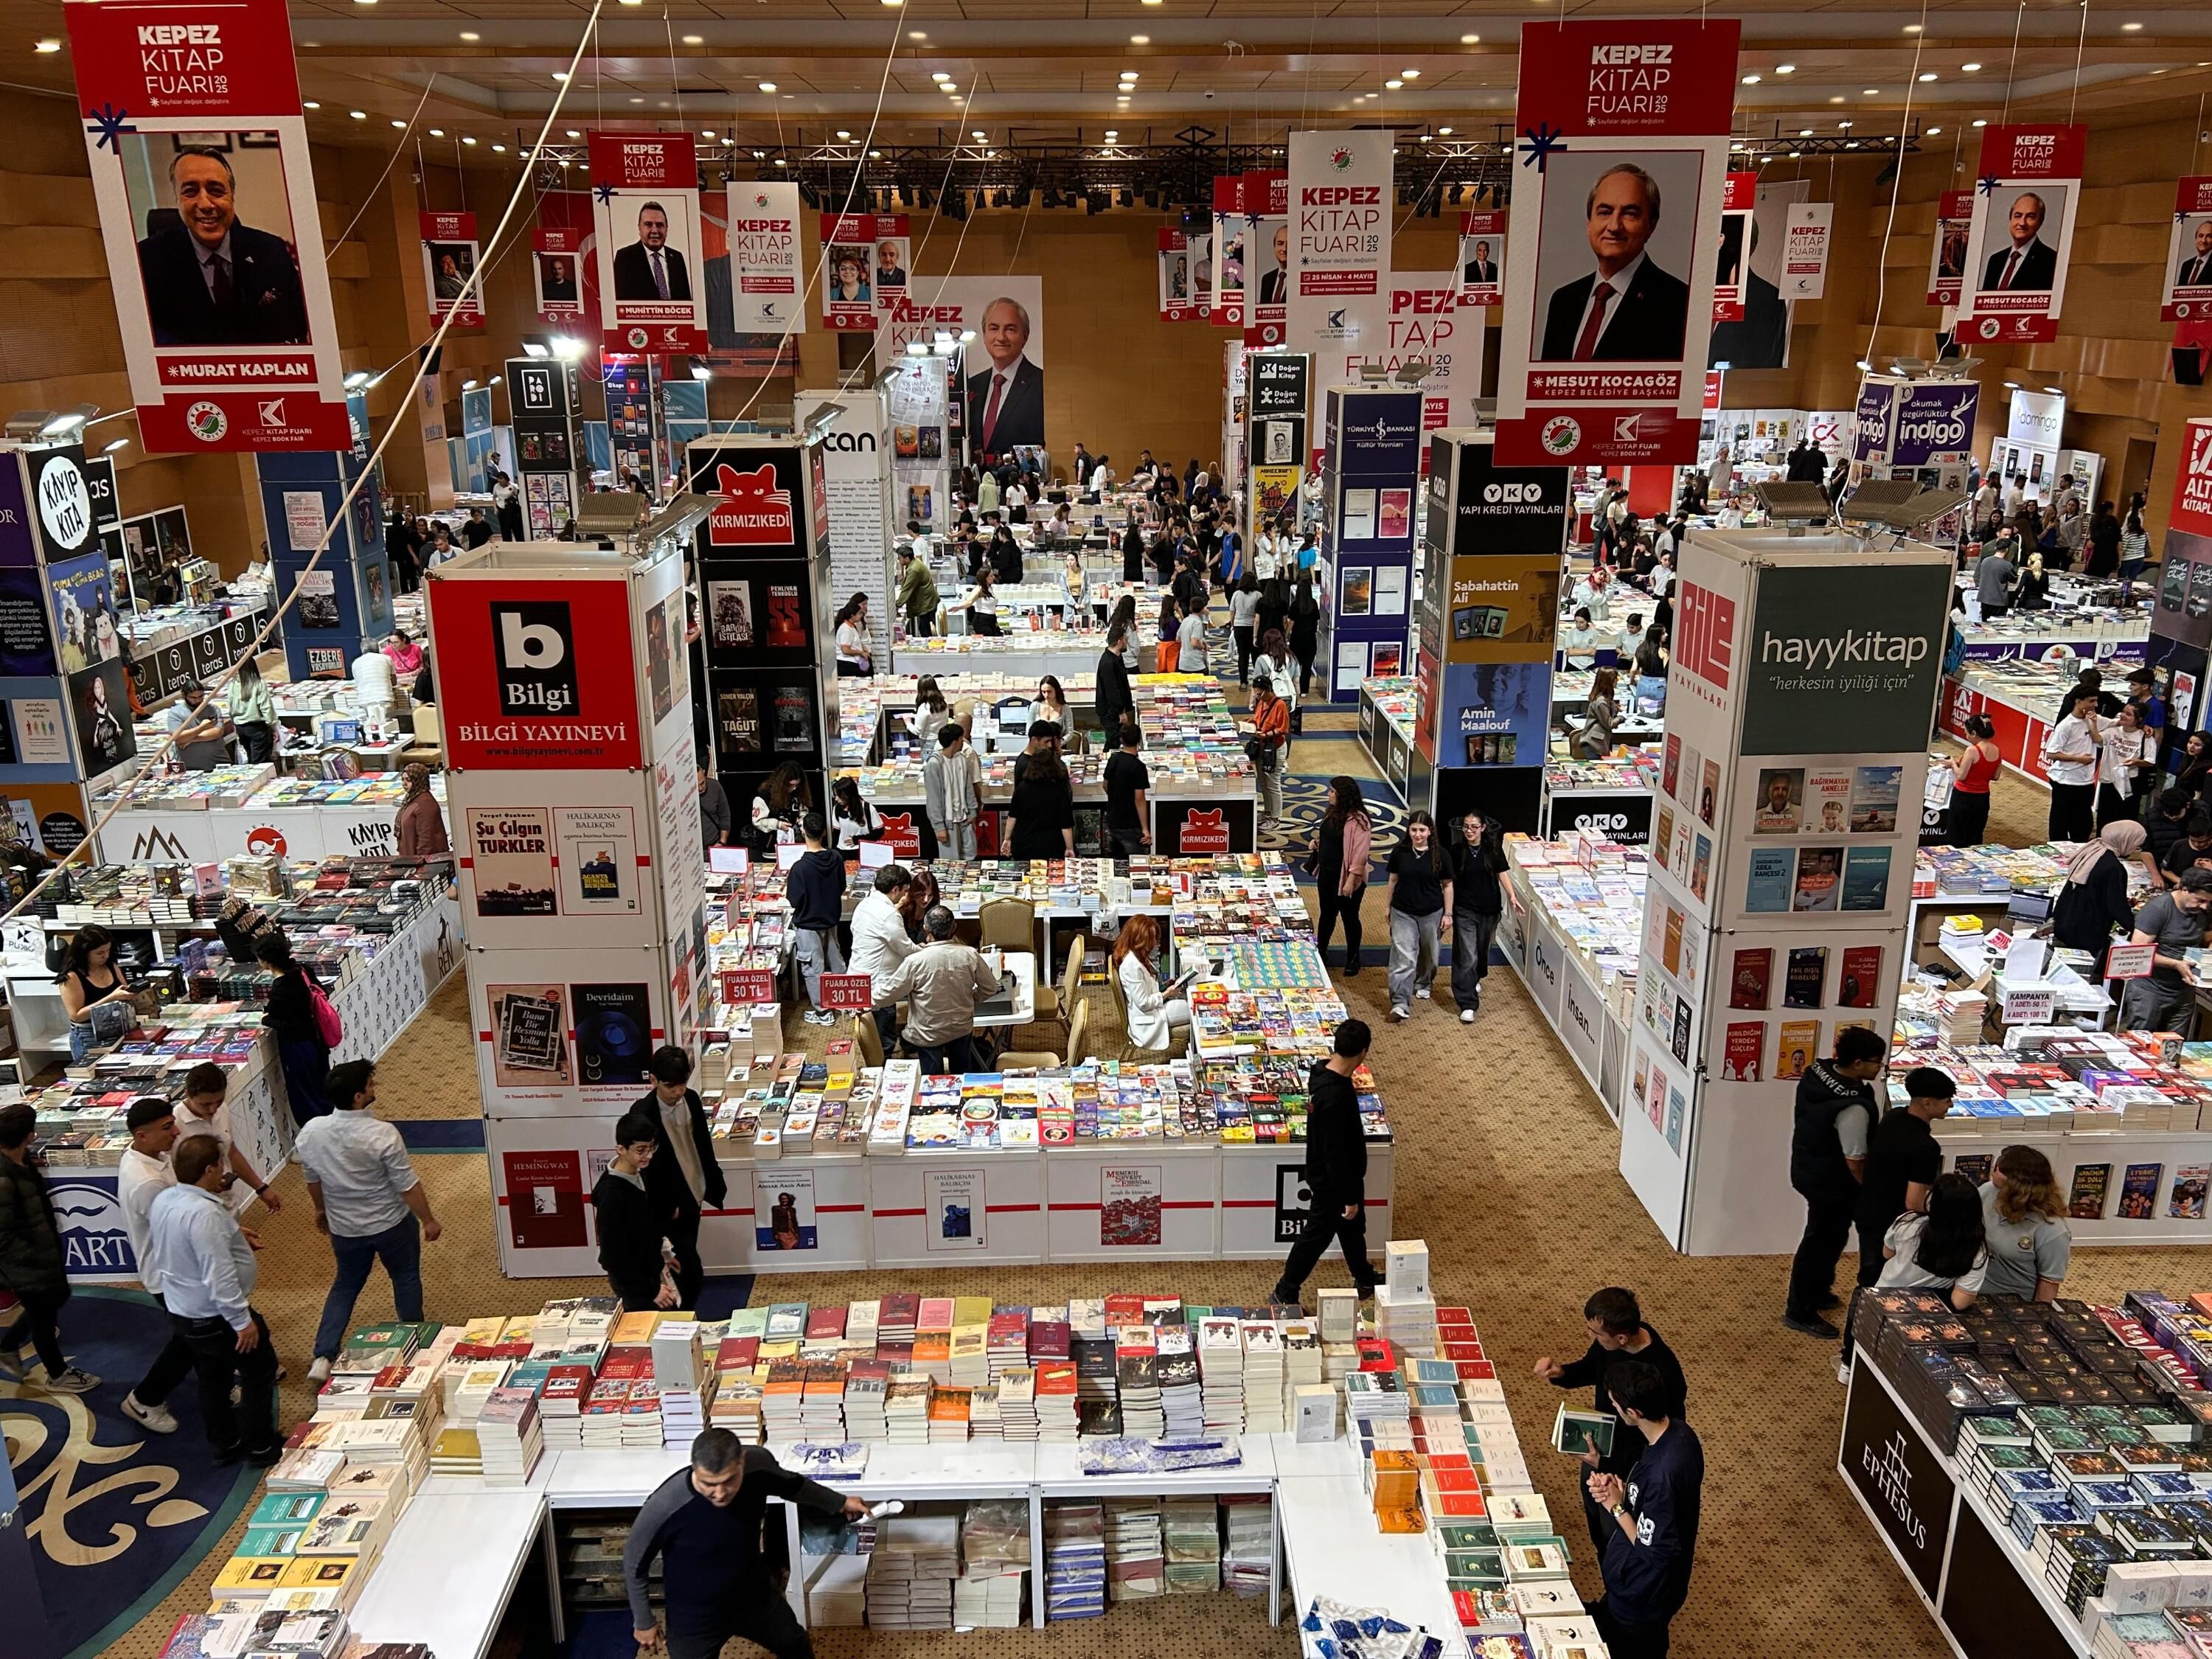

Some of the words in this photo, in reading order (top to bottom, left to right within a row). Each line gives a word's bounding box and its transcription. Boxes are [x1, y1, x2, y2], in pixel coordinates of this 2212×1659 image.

[137, 24, 221, 45] KEPEZ
[1592, 45, 1673, 65] KEPEZ
[145, 75, 213, 94] FUARI
[214, 75, 227, 84] 20
[215, 84, 228, 93] 25
[1587, 95, 1653, 114] FUARI
[1655, 95, 1668, 104] 20
[1654, 105, 1666, 113] 25
[2016, 135, 2056, 145] KEPEZ
[623, 144, 664, 154] KEPEZ
[2012, 159, 2045, 169] FUARI
[625, 168, 658, 178] FUARI
[1301, 187, 1381, 206] KEPEZ
[737, 220, 792, 232] KEPEZ
[1792, 226, 1826, 235] KEPEZ
[1301, 234, 1364, 253] FUARI
[1366, 234, 1379, 243] 20
[1366, 244, 1378, 252] 25
[1789, 248, 1817, 256] FUARI
[739, 252, 783, 265] FUARI
[1389, 290, 1455, 314] PEZ
[2011, 296, 2048, 304] KOCAGÖZ
[625, 306, 664, 314] MUHİTTİN
[664, 306, 692, 314] BÖCEK
[891, 306, 963, 323] KEPEZ
[1436, 354, 1452, 365] 20
[179, 364, 236, 377] MURAT
[240, 363, 308, 376] KAPLAN
[1279, 364, 1300, 373] Doğan
[1435, 366, 1450, 377] 25
[1545, 376, 1599, 387] MESUT
[1601, 373, 1677, 387] KOCAGÖZ
[1274, 389, 1298, 397] Doğan
[1580, 388, 1629, 396] BELEDİYE
[1632, 389, 1676, 397] BAŞKANI
[1910, 399, 1943, 408] okumak
[1902, 409, 1949, 420] özgürlüktür
[1546, 419, 1577, 431] KEPEZ
[2020, 410, 2057, 432] domingo
[1347, 424, 1375, 433] TÜRKİYE
[1857, 416, 1885, 443] indigo
[1899, 420, 1963, 445] indigo
[823, 431, 876, 452] can
[1377, 441, 1404, 449] Yayınları
[43, 470, 77, 510] KAYIP
[1484, 483, 1543, 503] YKY
[1459, 505, 1481, 515] YAPI
[1483, 503, 1512, 515] KREDİ
[1514, 505, 1564, 515] YAYINLARI
[712, 511, 790, 528] KIRMIZIKEDİ
[88, 567, 105, 583] BEAR
[52, 579, 72, 591] KUMA
[1453, 580, 1519, 591] Sabahattin
[1453, 592, 1469, 604] Ali
[500, 612, 565, 669] b
[1761, 629, 1928, 670] hayykitap
[2116, 648, 2140, 656] okumak
[309, 650, 341, 664] EZBERE
[202, 655, 223, 675] teras
[167, 670, 191, 691] teras
[1839, 674, 1879, 692] iyiliği
[2175, 680, 2192, 693] KING
[506, 683, 572, 712] Bilgi
[1674, 672, 1727, 712] YAYINLARI
[1461, 706, 1496, 719] Amin
[723, 717, 757, 731] TAĞUT
[1461, 718, 1511, 731] Maalouf
[459, 721, 518, 741] BİLGİ
[521, 721, 627, 741] YAYINEVİ
[1809, 777, 1850, 785] BAĞIRMAYAN
[1820, 785, 1848, 793] ANNELER
[567, 812, 621, 820] HALİKARNAS
[1575, 813, 1628, 830] YKY
[476, 821, 495, 838] Şu
[498, 820, 542, 838] Çılgın
[575, 821, 615, 830] BALIKÇISI
[348, 823, 392, 846] KAYIP
[1182, 834, 1227, 844] KIRMIZIKEDİ
[1780, 869, 1787, 877] 2
[1535, 939, 1554, 986] Önce
[727, 975, 750, 984] FUARA
[751, 973, 769, 982] ÖZEL
[825, 979, 849, 987] FUARA
[850, 978, 869, 987] ÖZEL
[586, 993, 634, 1001] Devridaim
[734, 985, 746, 998] 50
[749, 984, 764, 997] TL
[832, 990, 845, 1003] 30
[848, 990, 863, 1003] TL
[522, 1010, 546, 1021] Bana
[525, 1019, 540, 1029] Bir
[513, 1025, 548, 1037] Resmini
[519, 1035, 540, 1046] Yolla
[1731, 1045, 1755, 1053] GÜÇLEN
[513, 1162, 570, 1170] HEMINGWAY
[1106, 1169, 1138, 1178] MEMDUH
[66, 1236, 128, 1267] ART
[1861, 1442, 1927, 1550] EPHESUS
